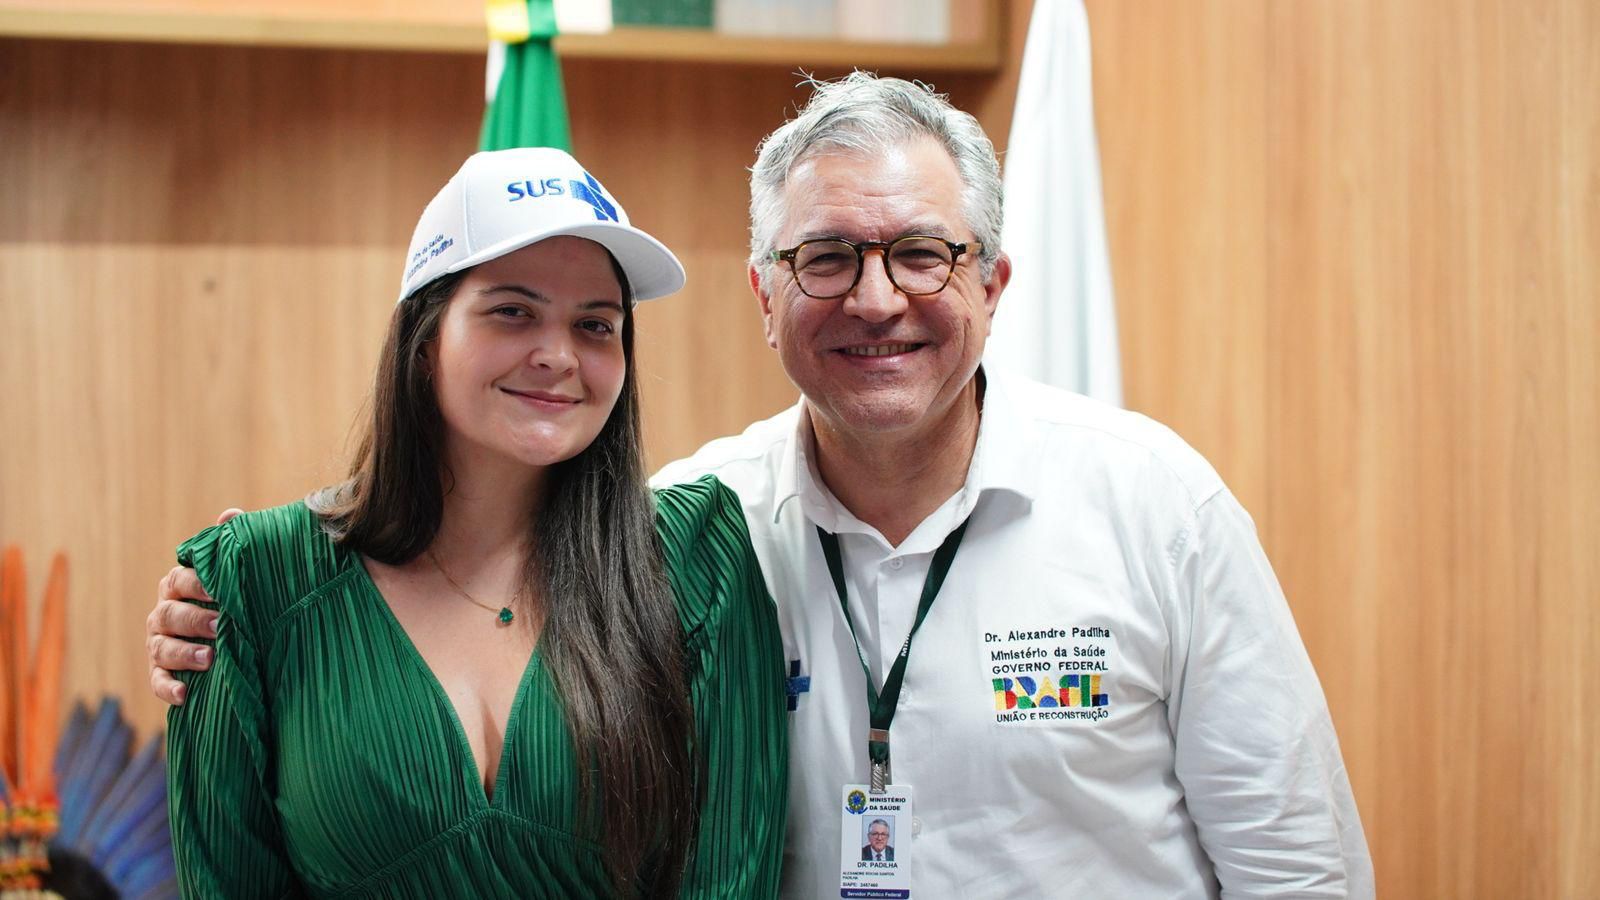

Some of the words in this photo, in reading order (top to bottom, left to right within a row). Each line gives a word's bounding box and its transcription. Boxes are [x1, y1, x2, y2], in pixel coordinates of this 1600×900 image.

[507, 178, 565, 202] SUS
[985, 632, 1002, 643] Dr.
[1008, 627, 1066, 642] Alexandre
[1072, 626, 1110, 638] Padilha
[991, 647, 1048, 661] Ministério
[1054, 647, 1067, 657] da
[1073, 645, 1106, 657] Saúde
[992, 662, 1051, 675] GOVERNO
[1059, 661, 1109, 671] FEDERAL
[992, 674, 1109, 711] BRASIL
[996, 711, 1027, 723] UNIÃO
[1039, 708, 1109, 722] RECONSTRUÇÃO
